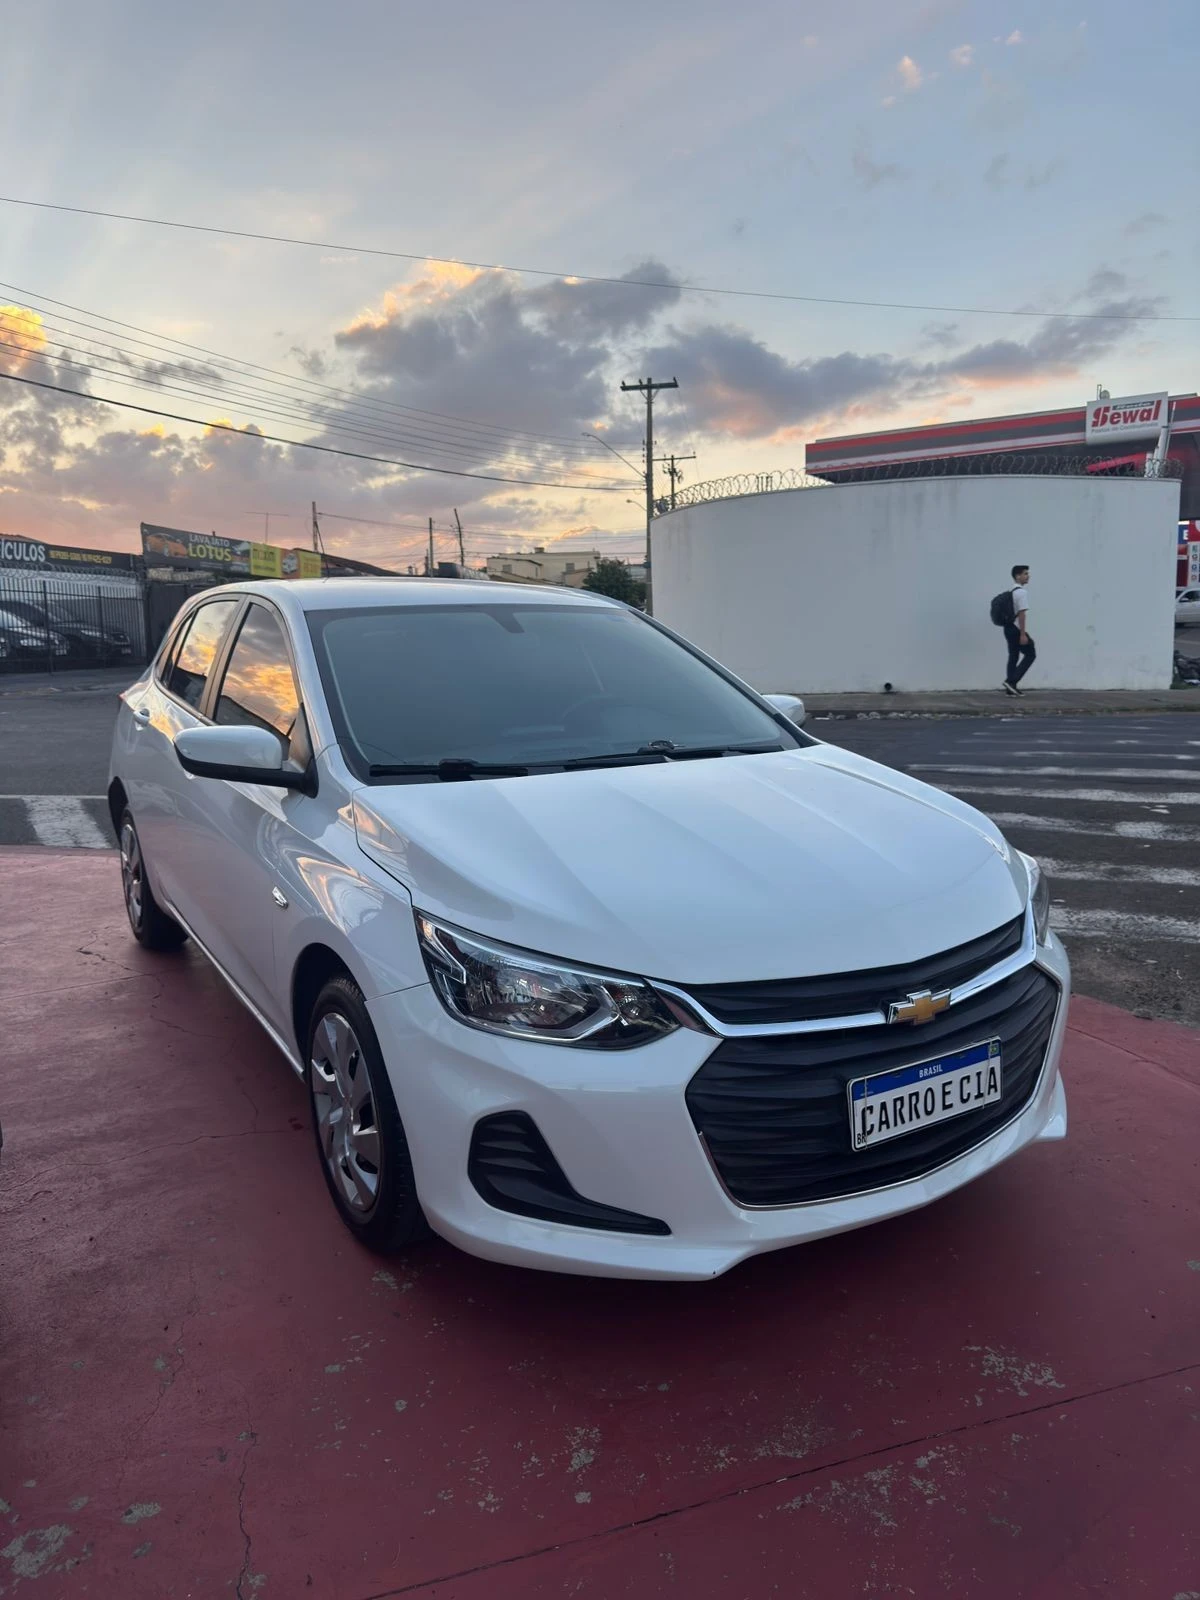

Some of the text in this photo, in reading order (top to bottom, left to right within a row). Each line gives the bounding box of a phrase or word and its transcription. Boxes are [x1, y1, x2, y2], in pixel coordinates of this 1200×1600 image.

[1091, 400, 1162, 428] Sewal
[0, 538, 45, 562] ÍCULOS
[189, 543, 231, 562] LOTUS
[919, 1064, 943, 1078] BRASIL
